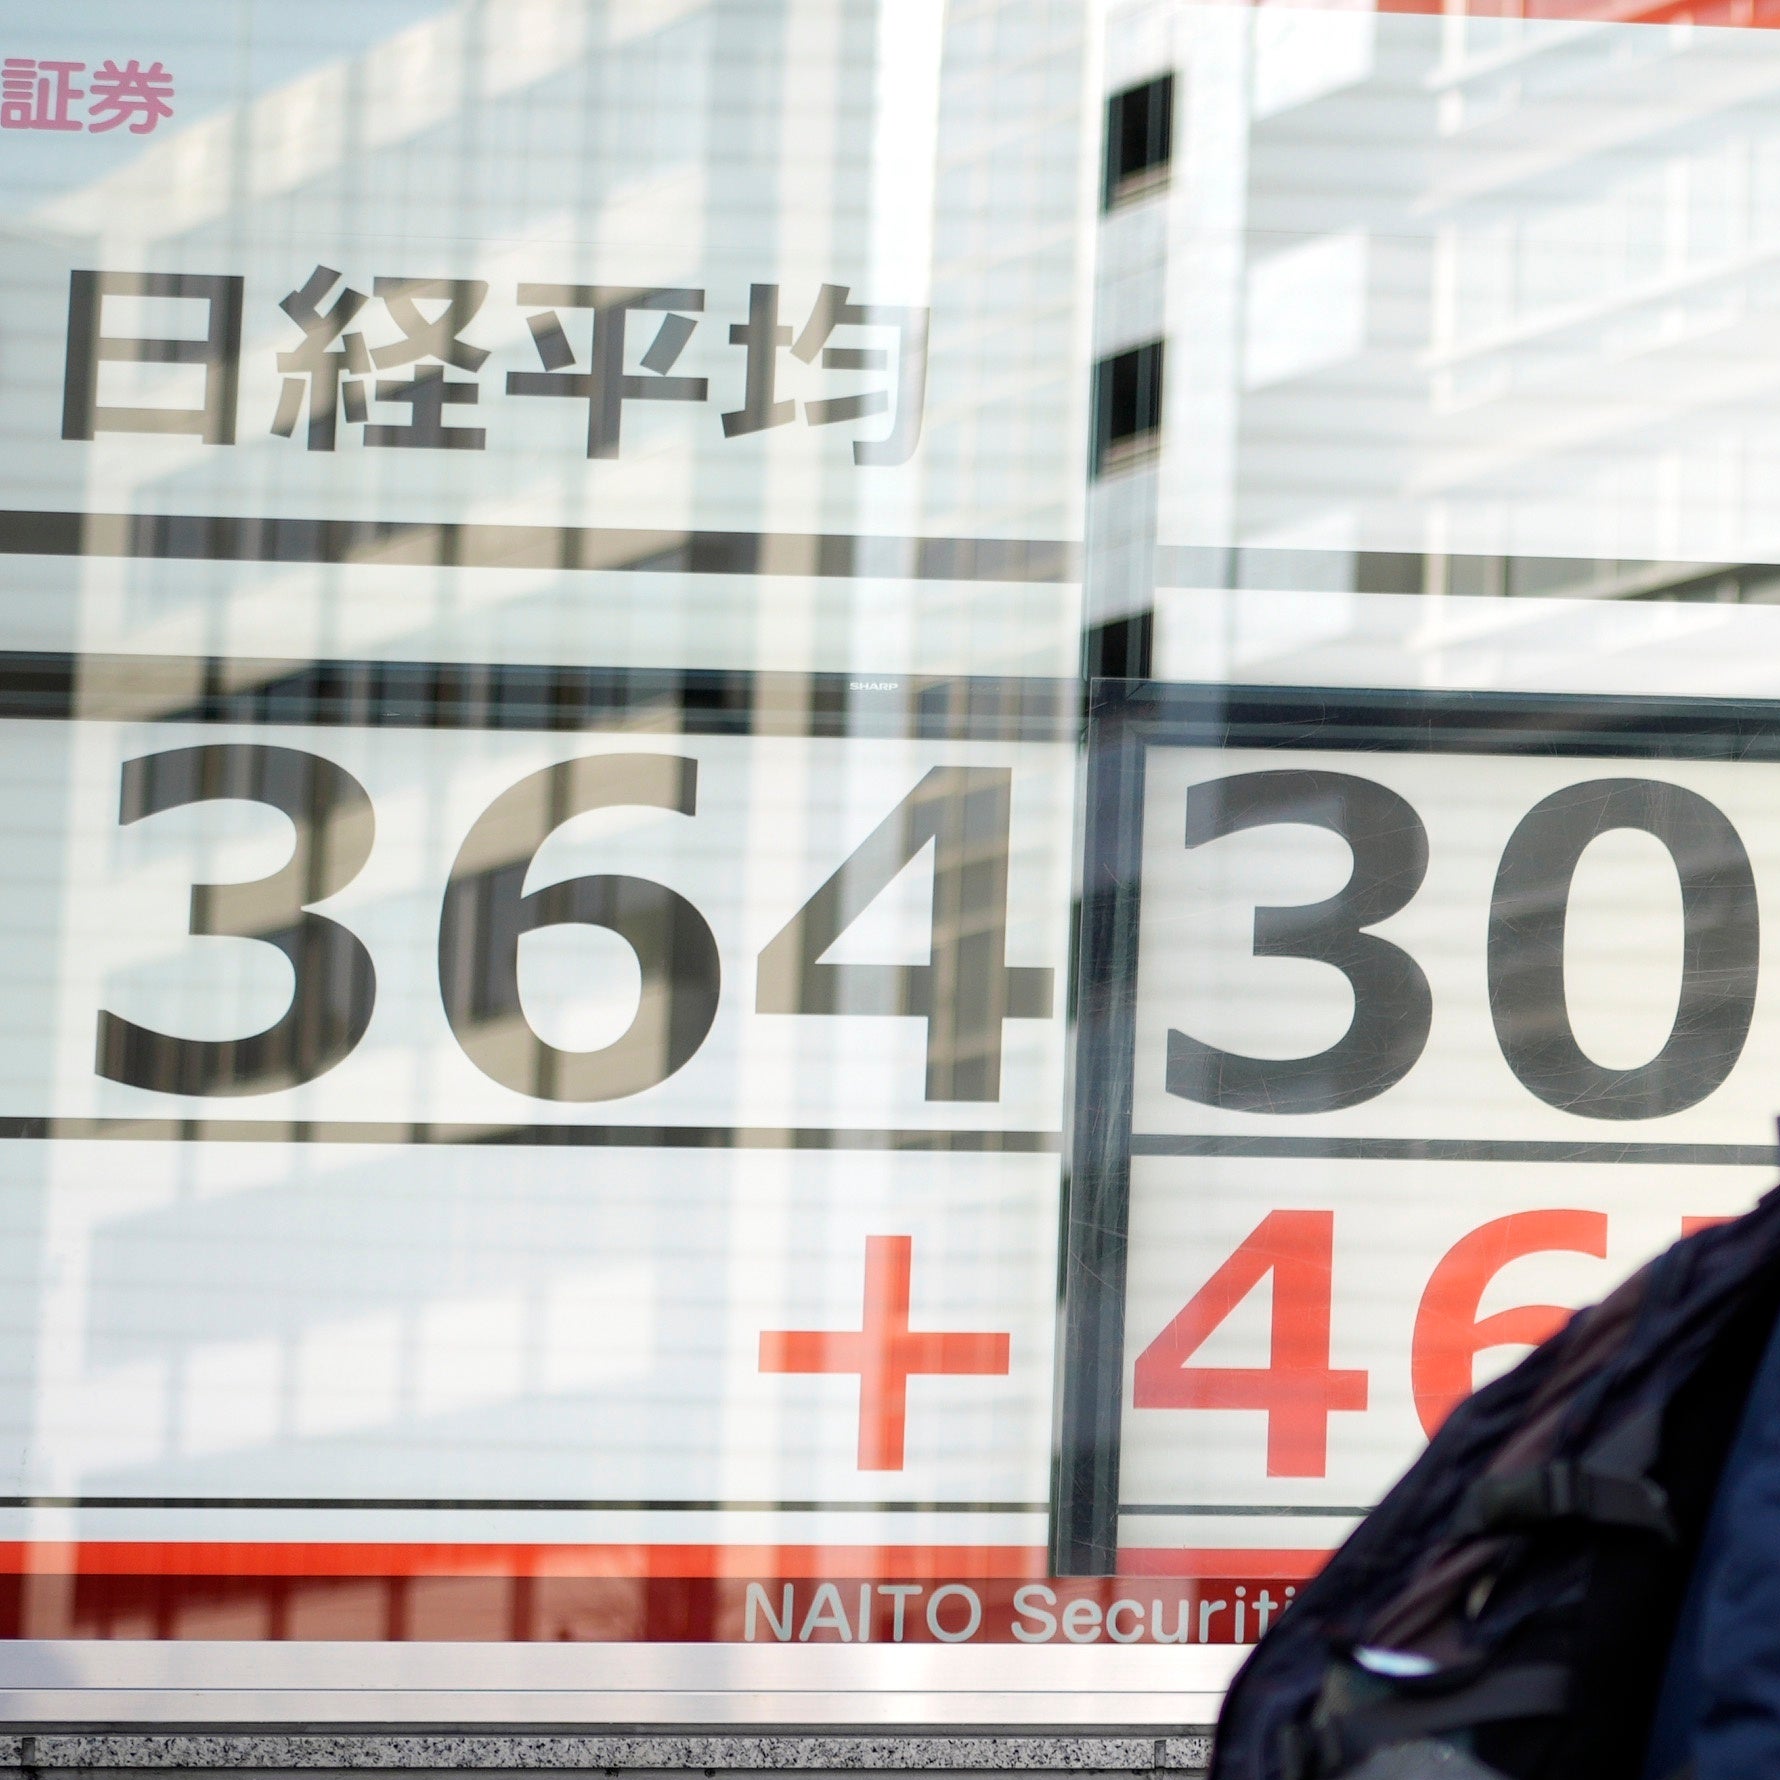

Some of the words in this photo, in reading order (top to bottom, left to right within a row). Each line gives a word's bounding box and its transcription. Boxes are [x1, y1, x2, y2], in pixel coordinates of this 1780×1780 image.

[0, 57, 176, 134] 証券
[61, 264, 931, 466] 日経平均
[850, 682, 899, 691] SHARP
[744, 1583, 982, 1643] NAITO
